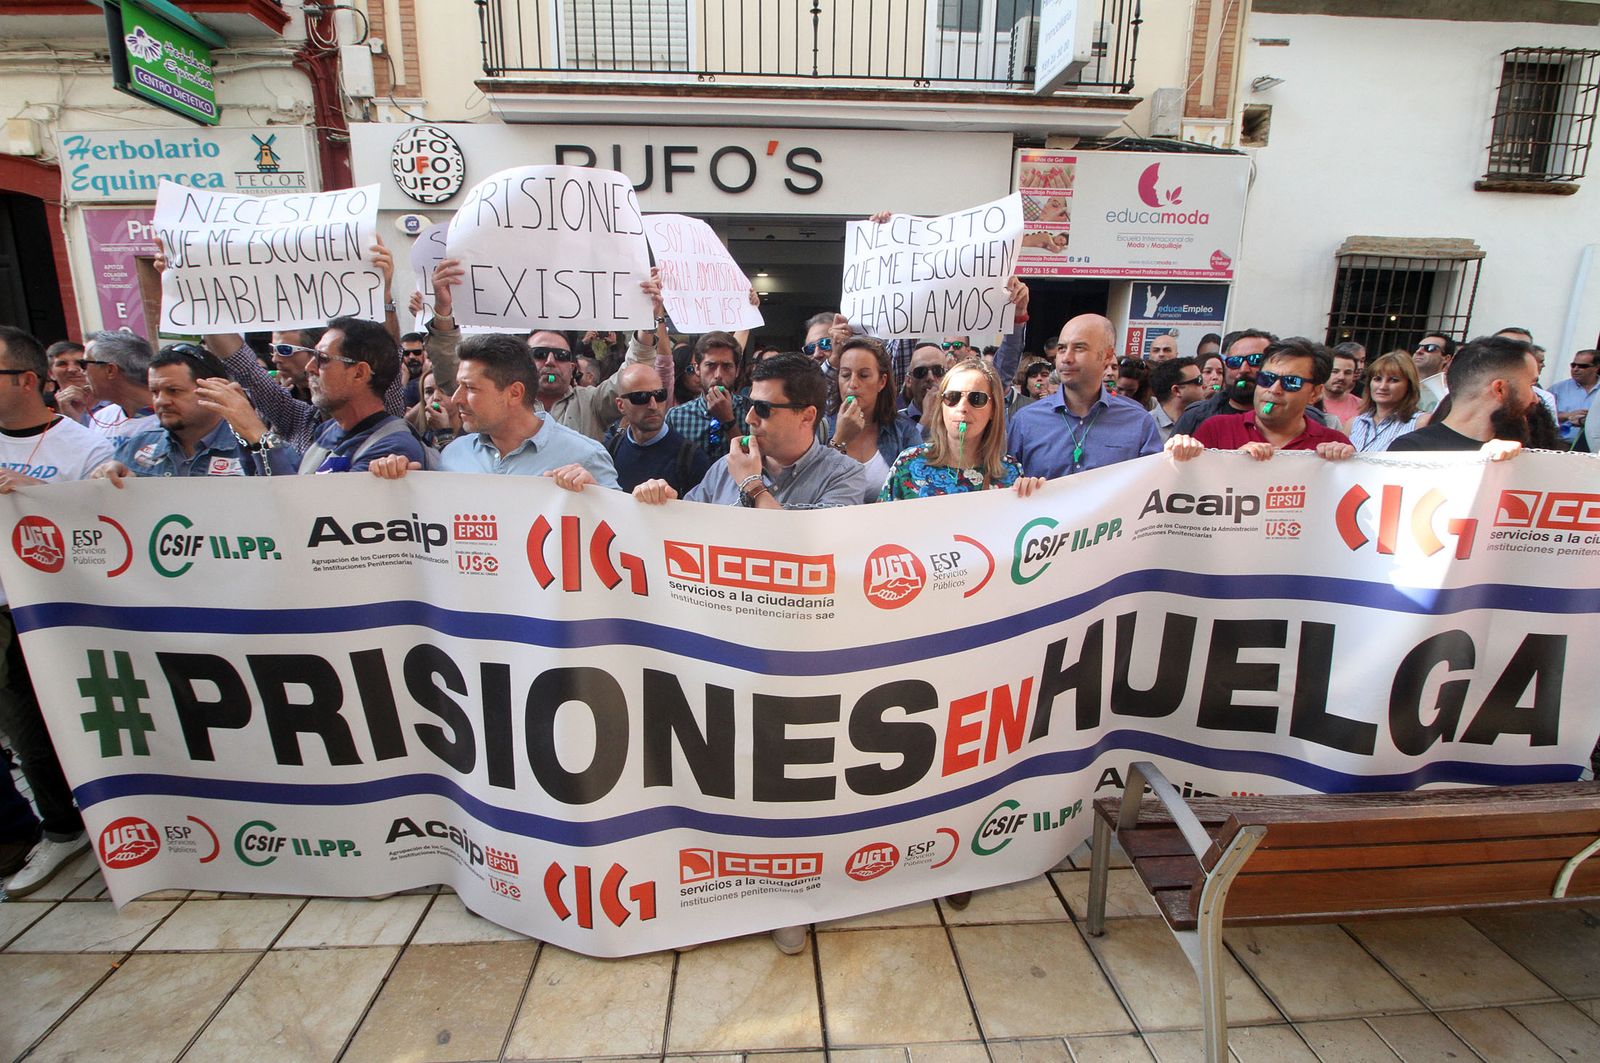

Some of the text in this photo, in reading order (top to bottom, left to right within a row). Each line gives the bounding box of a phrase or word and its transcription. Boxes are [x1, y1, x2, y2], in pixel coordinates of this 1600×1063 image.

[138, 71, 172, 94] CENTRO
[63, 135, 220, 161] Herbolario
[71, 164, 225, 196] Equinacea
[236, 175, 306, 186] TEGOR
[179, 191, 367, 226] NECESITO
[454, 177, 644, 236] PRISIONES
[1106, 208, 1209, 225] educamoda
[855, 206, 1006, 256] NECESITO
[1142, 235, 1183, 243] Internacional
[207, 228, 241, 266] ME
[248, 222, 362, 264] ESCUCHEN
[843, 239, 1015, 294] QUE ME ESCUCHEN
[169, 271, 381, 326] ¿HABLAMOS?
[470, 264, 632, 320] EXISTE
[116, 303, 128, 318] E
[694, 296, 716, 326] ME
[1158, 305, 1213, 314] educaEmpleo
[1137, 487, 1260, 524] Acaip
[1269, 494, 1301, 506] EPSU
[307, 513, 448, 553] Acaip
[458, 524, 493, 538] EPSU
[1174, 523, 1200, 531] Cuerpos
[1266, 522, 1301, 536] USO
[1335, 483, 1479, 560] CIG
[20, 525, 56, 548] UGT
[1023, 517, 1123, 564] CSIF II.PP.
[1167, 530, 1212, 539] Penitenciarias
[1490, 530, 1550, 542] servicios
[1554, 534, 1563, 543] a
[1567, 533, 1580, 544] la
[160, 534, 282, 560] CSIF II.PP.
[526, 514, 648, 597] CIG
[1486, 543, 1554, 554] instituciones
[73, 556, 106, 564] Públicos
[312, 557, 349, 565] Agrupación
[372, 553, 400, 561] Cuerpos
[323, 563, 366, 571] Instituciones
[368, 560, 412, 568] Penitenciarias
[458, 555, 498, 572] USO
[870, 553, 920, 583] UGT
[717, 554, 828, 588] CCOO
[933, 568, 968, 581] Servicios
[669, 580, 835, 608] servicios a la ciudadanía
[933, 580, 966, 590] Públicos
[670, 591, 835, 620] instituciones penitenciarias sae
[982, 799, 1083, 838] CSIF II.PP.
[103, 823, 151, 853] UGT
[244, 834, 361, 857] CSIF II.PP.
[385, 816, 485, 867] Acaip
[489, 854, 515, 871] EPSU
[725, 857, 817, 875] CCOO
[852, 846, 894, 869] UGT
[490, 878, 521, 898] USO
[543, 861, 657, 929] CIG
[680, 880, 733, 896] servicios
[746, 877, 755, 885] la
[759, 876, 821, 887] ciudadanía
[680, 890, 738, 908] instituciones
[806, 882, 821, 890] sae
